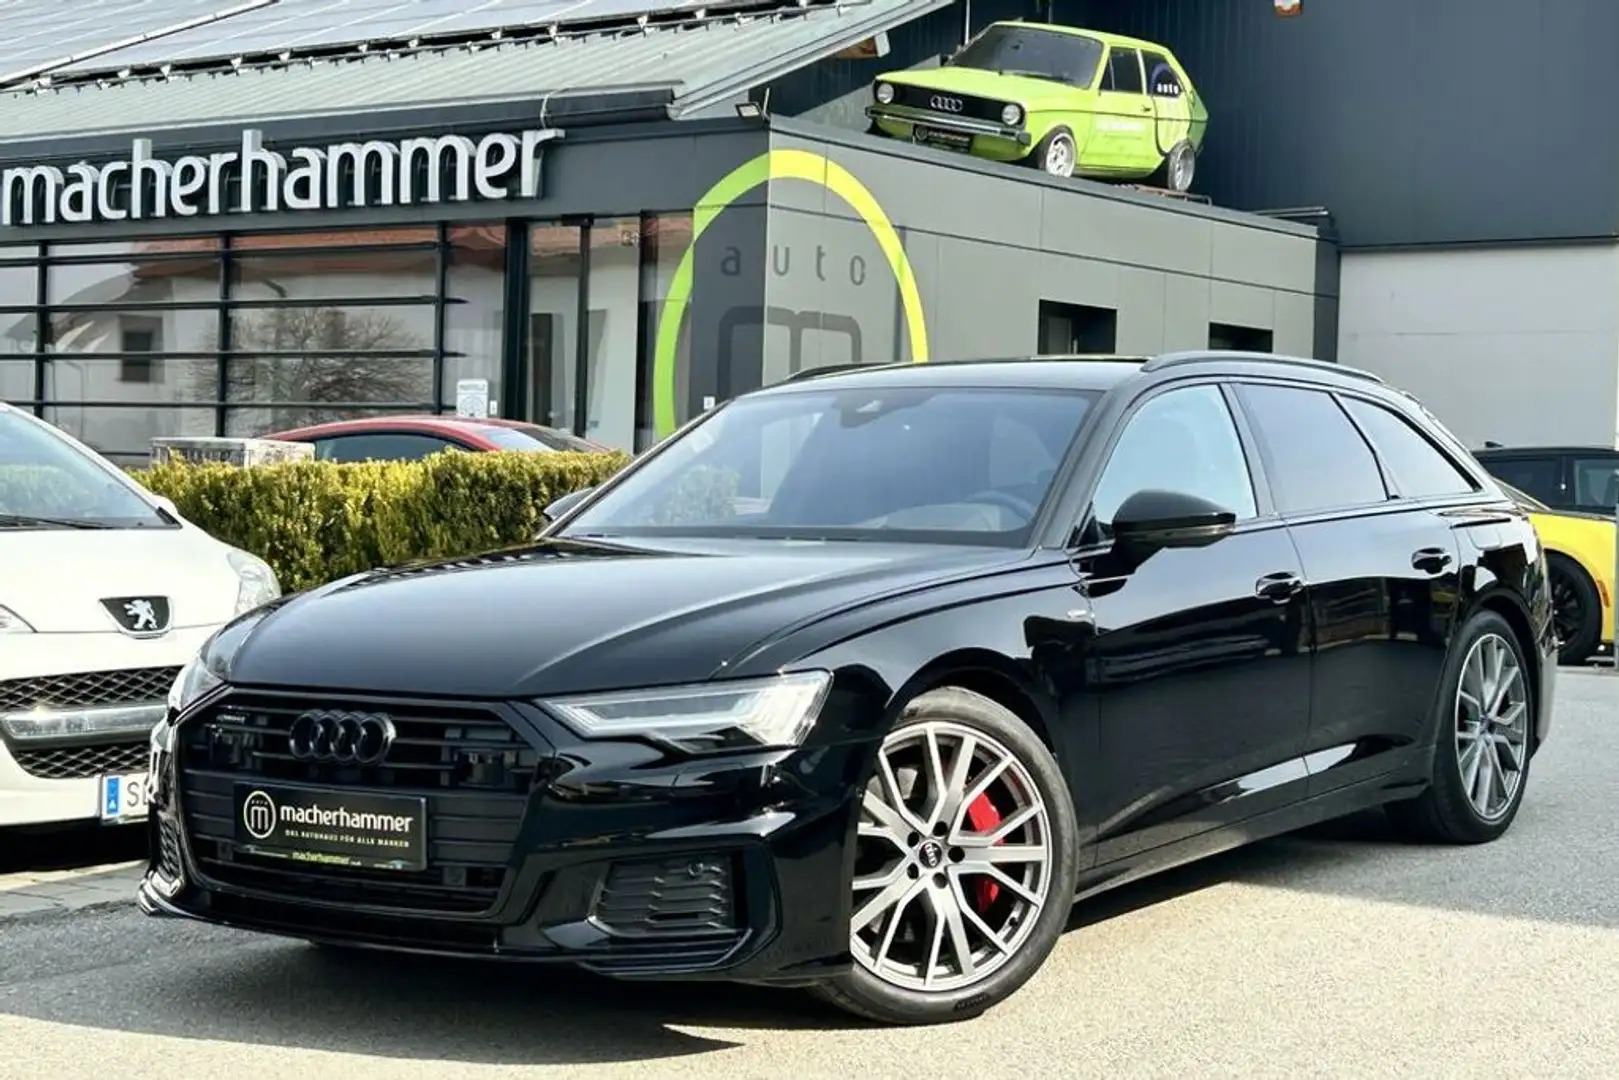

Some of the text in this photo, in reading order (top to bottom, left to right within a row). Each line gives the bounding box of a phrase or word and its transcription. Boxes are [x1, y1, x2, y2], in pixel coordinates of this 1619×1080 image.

[2, 129, 565, 226] macherhammer
[720, 245, 867, 286] auto
[280, 804, 413, 833] macherhammer
